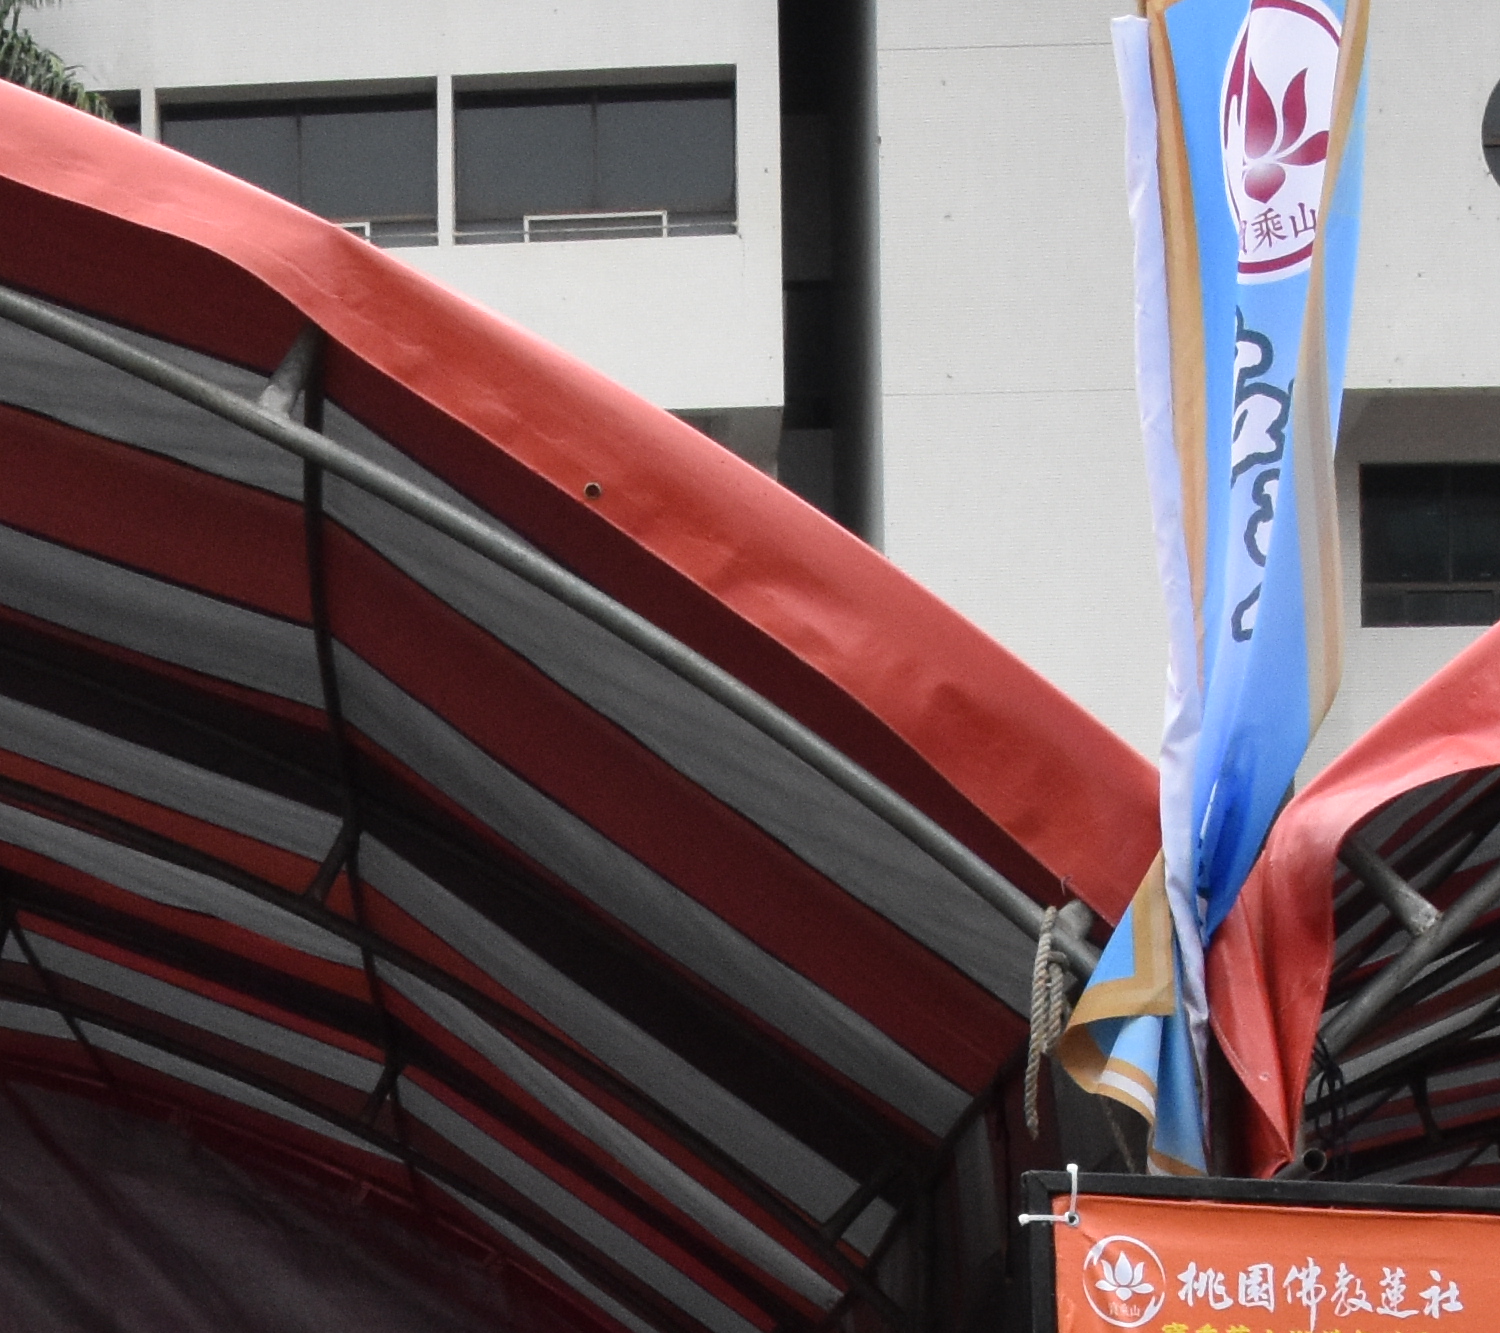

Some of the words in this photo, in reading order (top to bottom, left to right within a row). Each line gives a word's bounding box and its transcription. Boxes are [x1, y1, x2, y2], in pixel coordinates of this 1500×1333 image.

[1240, 202, 1317, 254] 乘山
[1176, 1256, 1464, 1333] 桃園佛教蓮社
